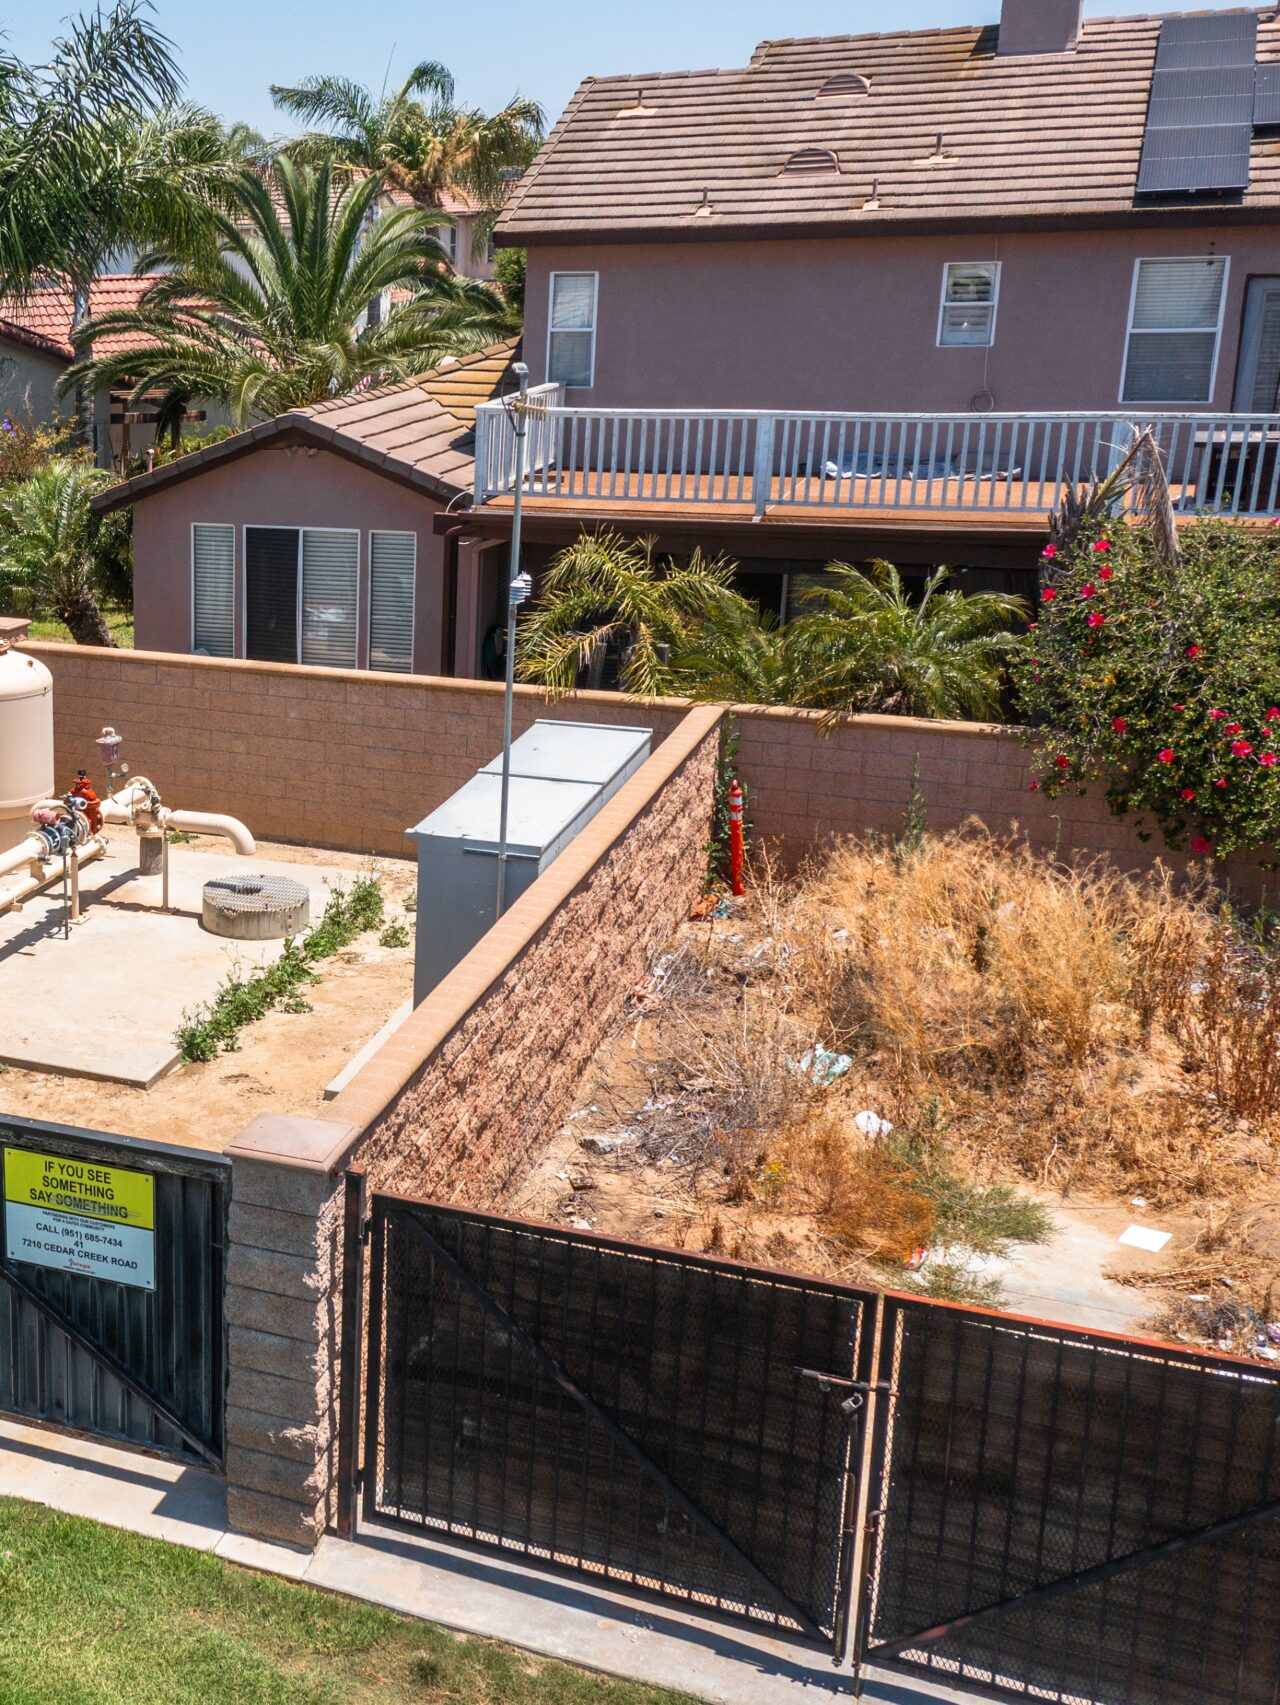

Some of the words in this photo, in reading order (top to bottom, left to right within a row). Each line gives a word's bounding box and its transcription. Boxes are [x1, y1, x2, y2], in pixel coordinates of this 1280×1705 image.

[45, 1160, 55, 1172] IF
[58, 1163, 83, 1179] YOU
[88, 1169, 111, 1184] SEE
[43, 1176, 114, 1200] SOMETHING
[30, 1188, 52, 1203] SAY
[56, 1194, 128, 1218] SOMETHING
[36, 1223, 59, 1234] CALL
[62, 1228, 82, 1240] (951)
[85, 1233, 122, 1247] 685-7434
[90, 1220, 115, 1229] CUSTOMERS
[22, 1238, 42, 1249] 7210
[44, 1243, 75, 1256] CEDAR
[78, 1250, 109, 1263] CREEK
[111, 1258, 138, 1269] ROAD
[74, 1240, 83, 1248] 41
